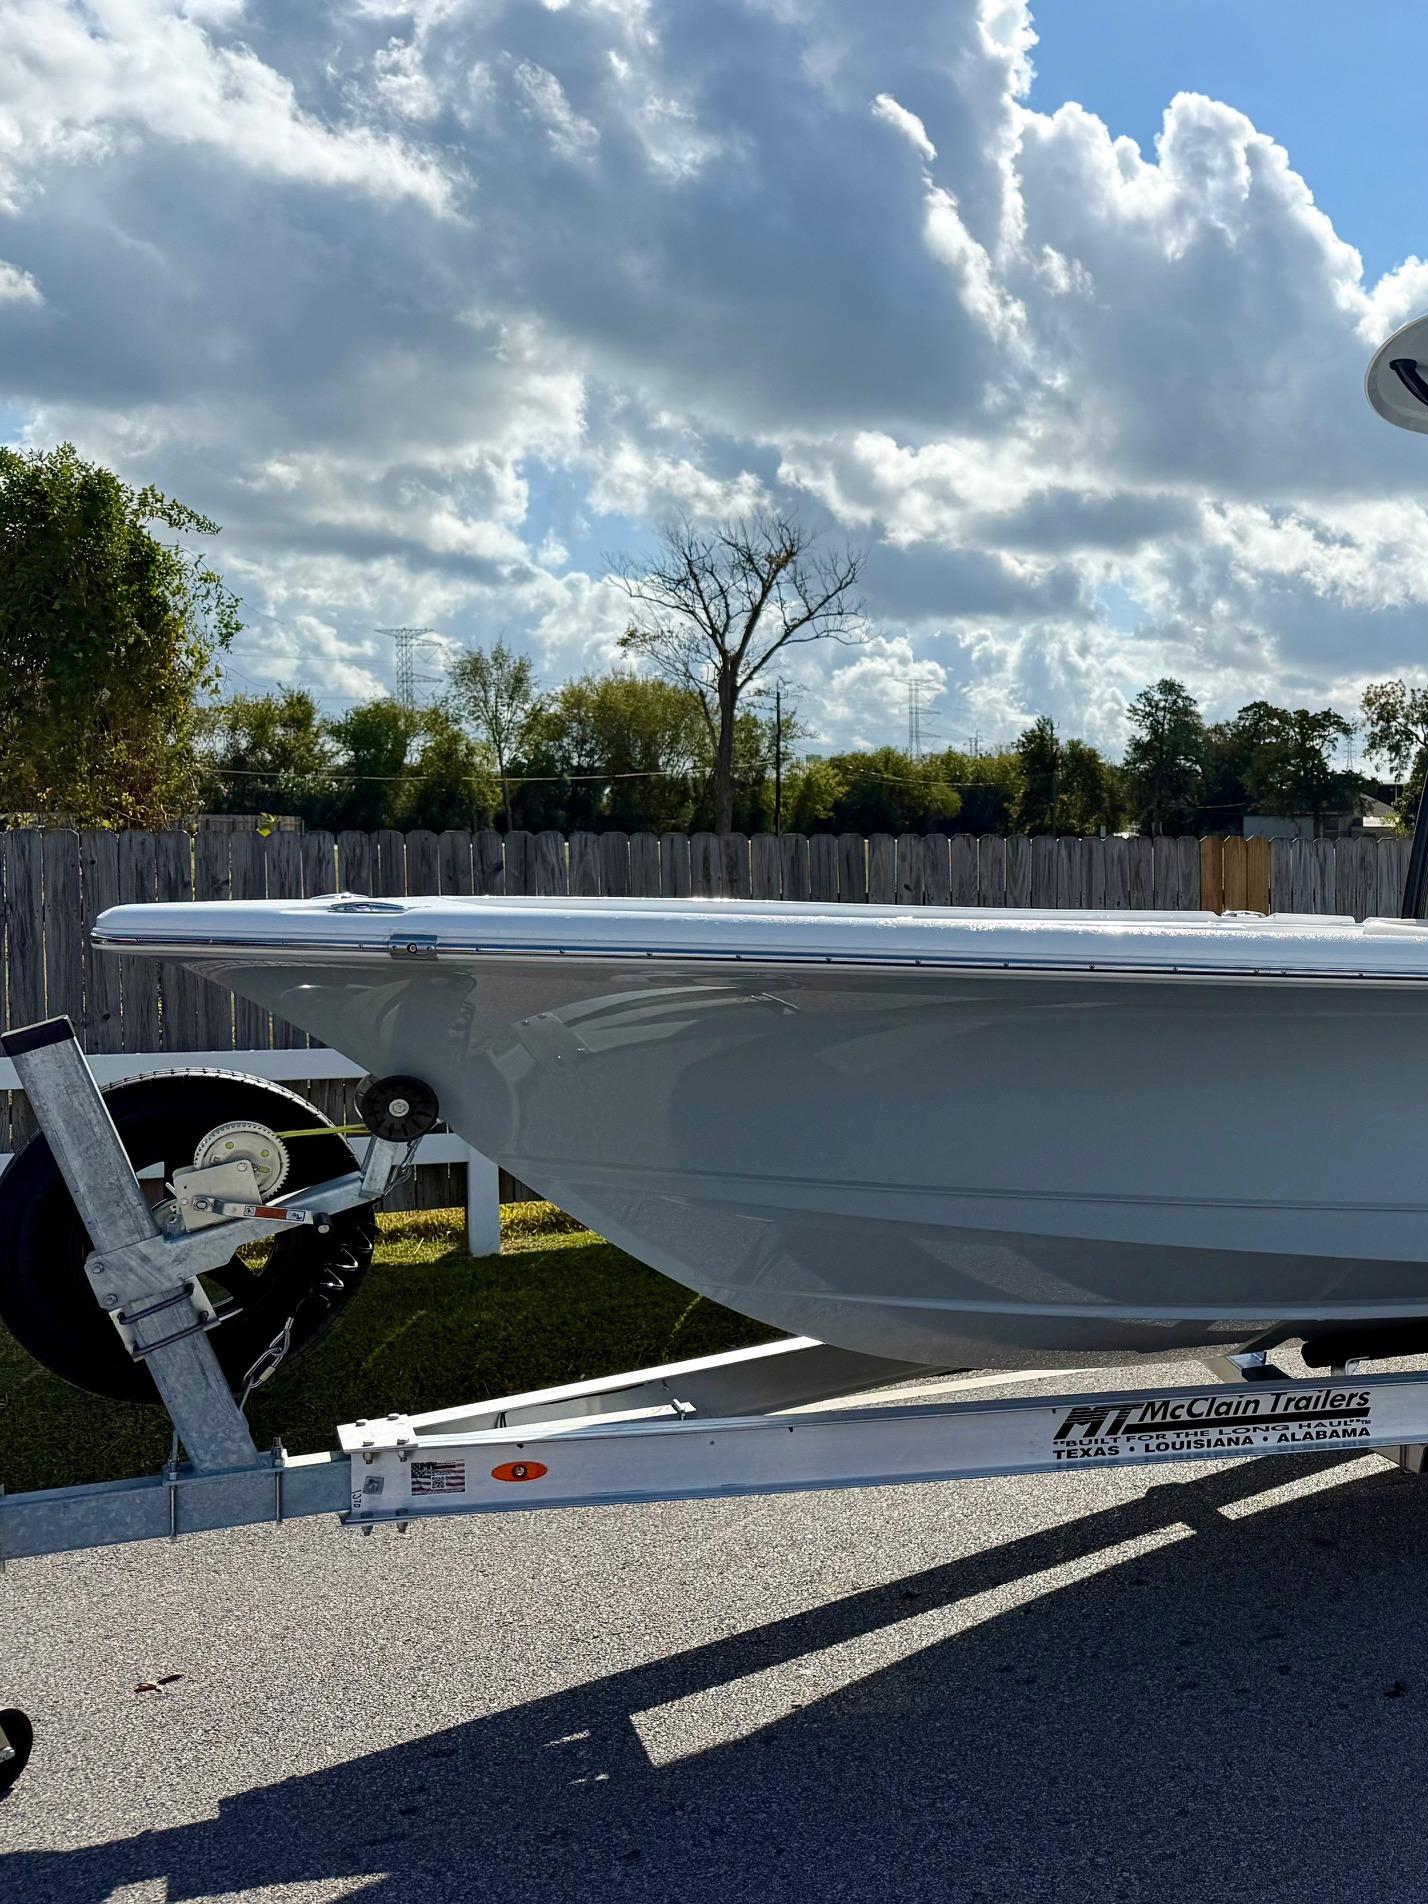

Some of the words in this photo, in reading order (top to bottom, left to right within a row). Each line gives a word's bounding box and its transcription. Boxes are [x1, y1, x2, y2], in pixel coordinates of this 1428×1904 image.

[1138, 1395, 1260, 1422] McClain
[1270, 1389, 1371, 1412] Trailers
[1053, 1445, 1120, 1460] TEXAS
[1144, 1435, 1254, 1453] LOUISIANA
[1276, 1427, 1371, 1443] ALABAMA
[1126, 1433, 1167, 1443] FOR
[1173, 1429, 1210, 1439] THE
[1218, 1424, 1290, 1436] LONG
